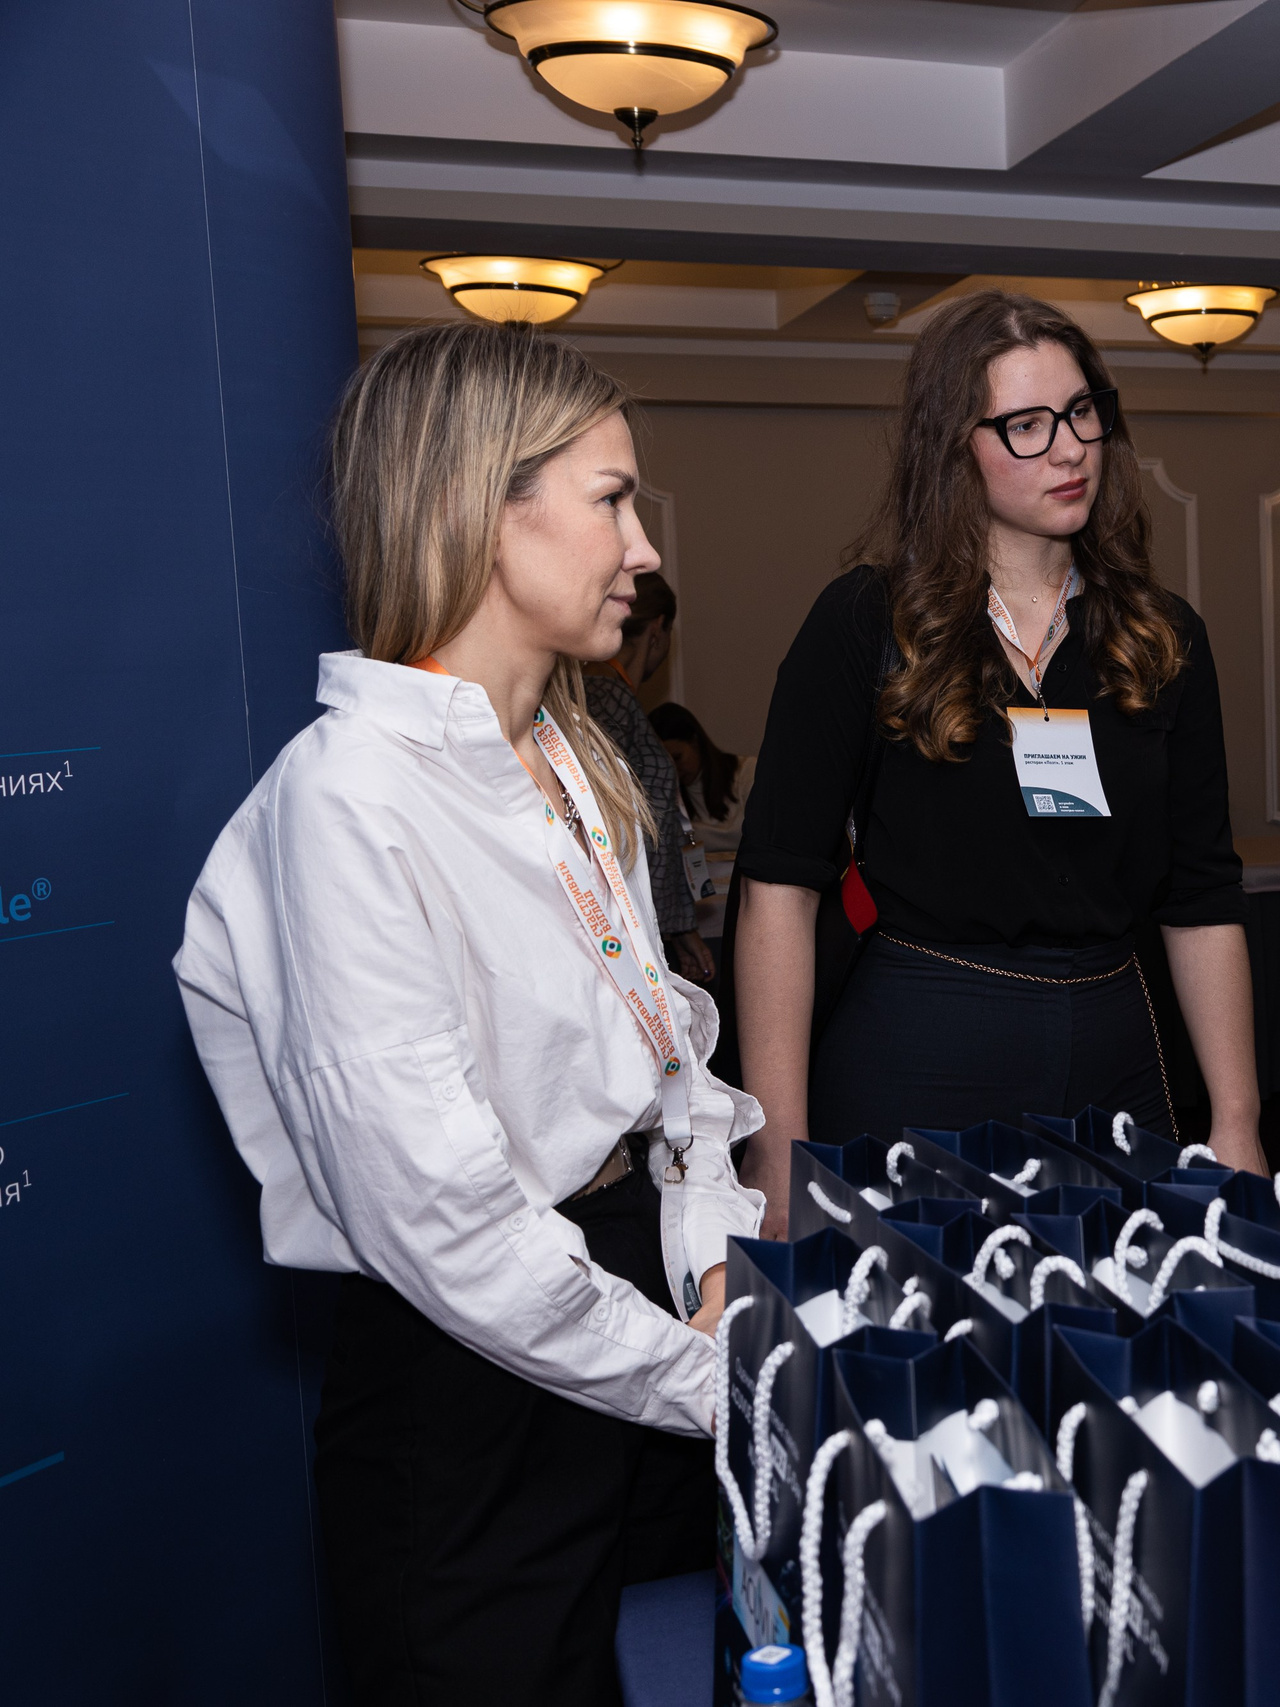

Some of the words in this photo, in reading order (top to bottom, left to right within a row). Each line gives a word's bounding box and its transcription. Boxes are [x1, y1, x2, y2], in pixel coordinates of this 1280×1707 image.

[988, 589, 1017, 640] ЧАСТЛИВЫЙ
[536, 726, 564, 768] ВЗГЛЯД
[542, 722, 591, 794] СЧАСТЛИВЫЙ
[553, 859, 605, 939] СЧАСТЛИВЫЙ
[583, 889, 613, 934] ВЗГЛЯД
[624, 987, 670, 1060] СЧАСТЛИВЫЙ
